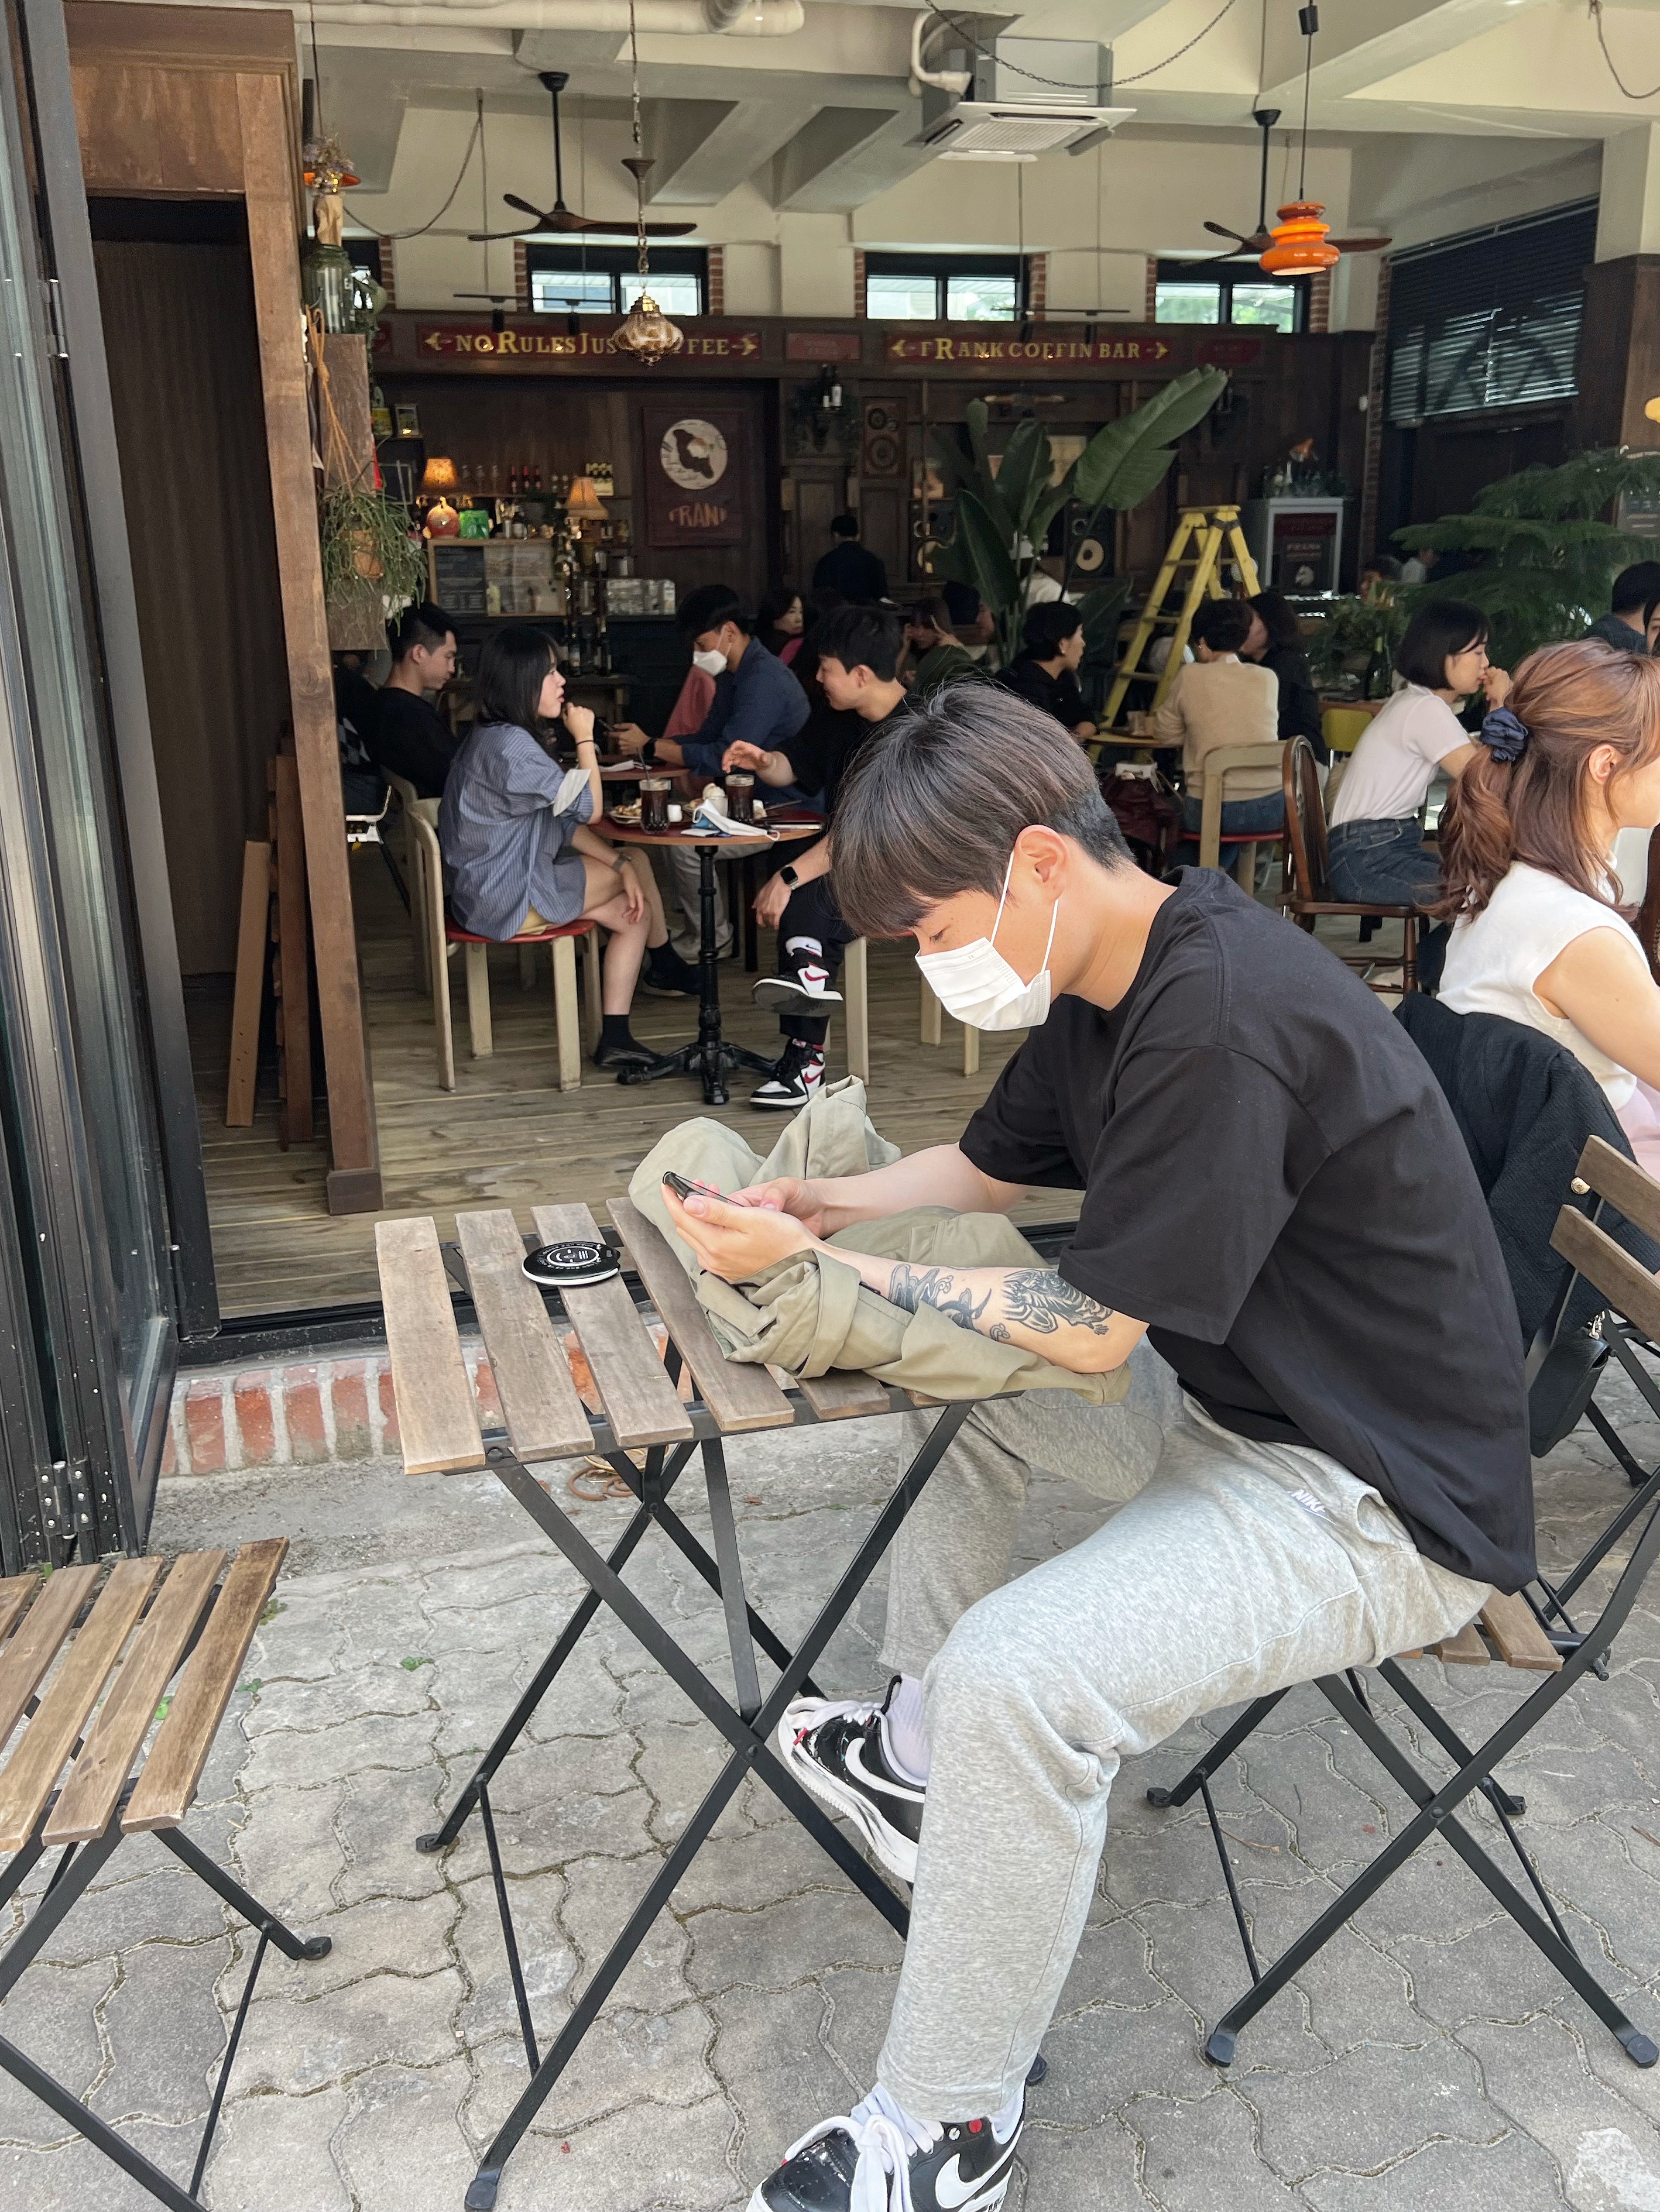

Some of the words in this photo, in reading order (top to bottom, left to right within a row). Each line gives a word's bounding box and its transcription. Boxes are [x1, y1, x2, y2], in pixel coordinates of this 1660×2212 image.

[455, 334, 493, 352] NO
[496, 331, 576, 354] RULES
[579, 332, 617, 355] JUS
[921, 338, 1004, 359] FRANK
[1008, 342, 1093, 360] COFFIN
[1099, 342, 1140, 358] BAR
[1290, 1489, 1326, 1513] NIKE
